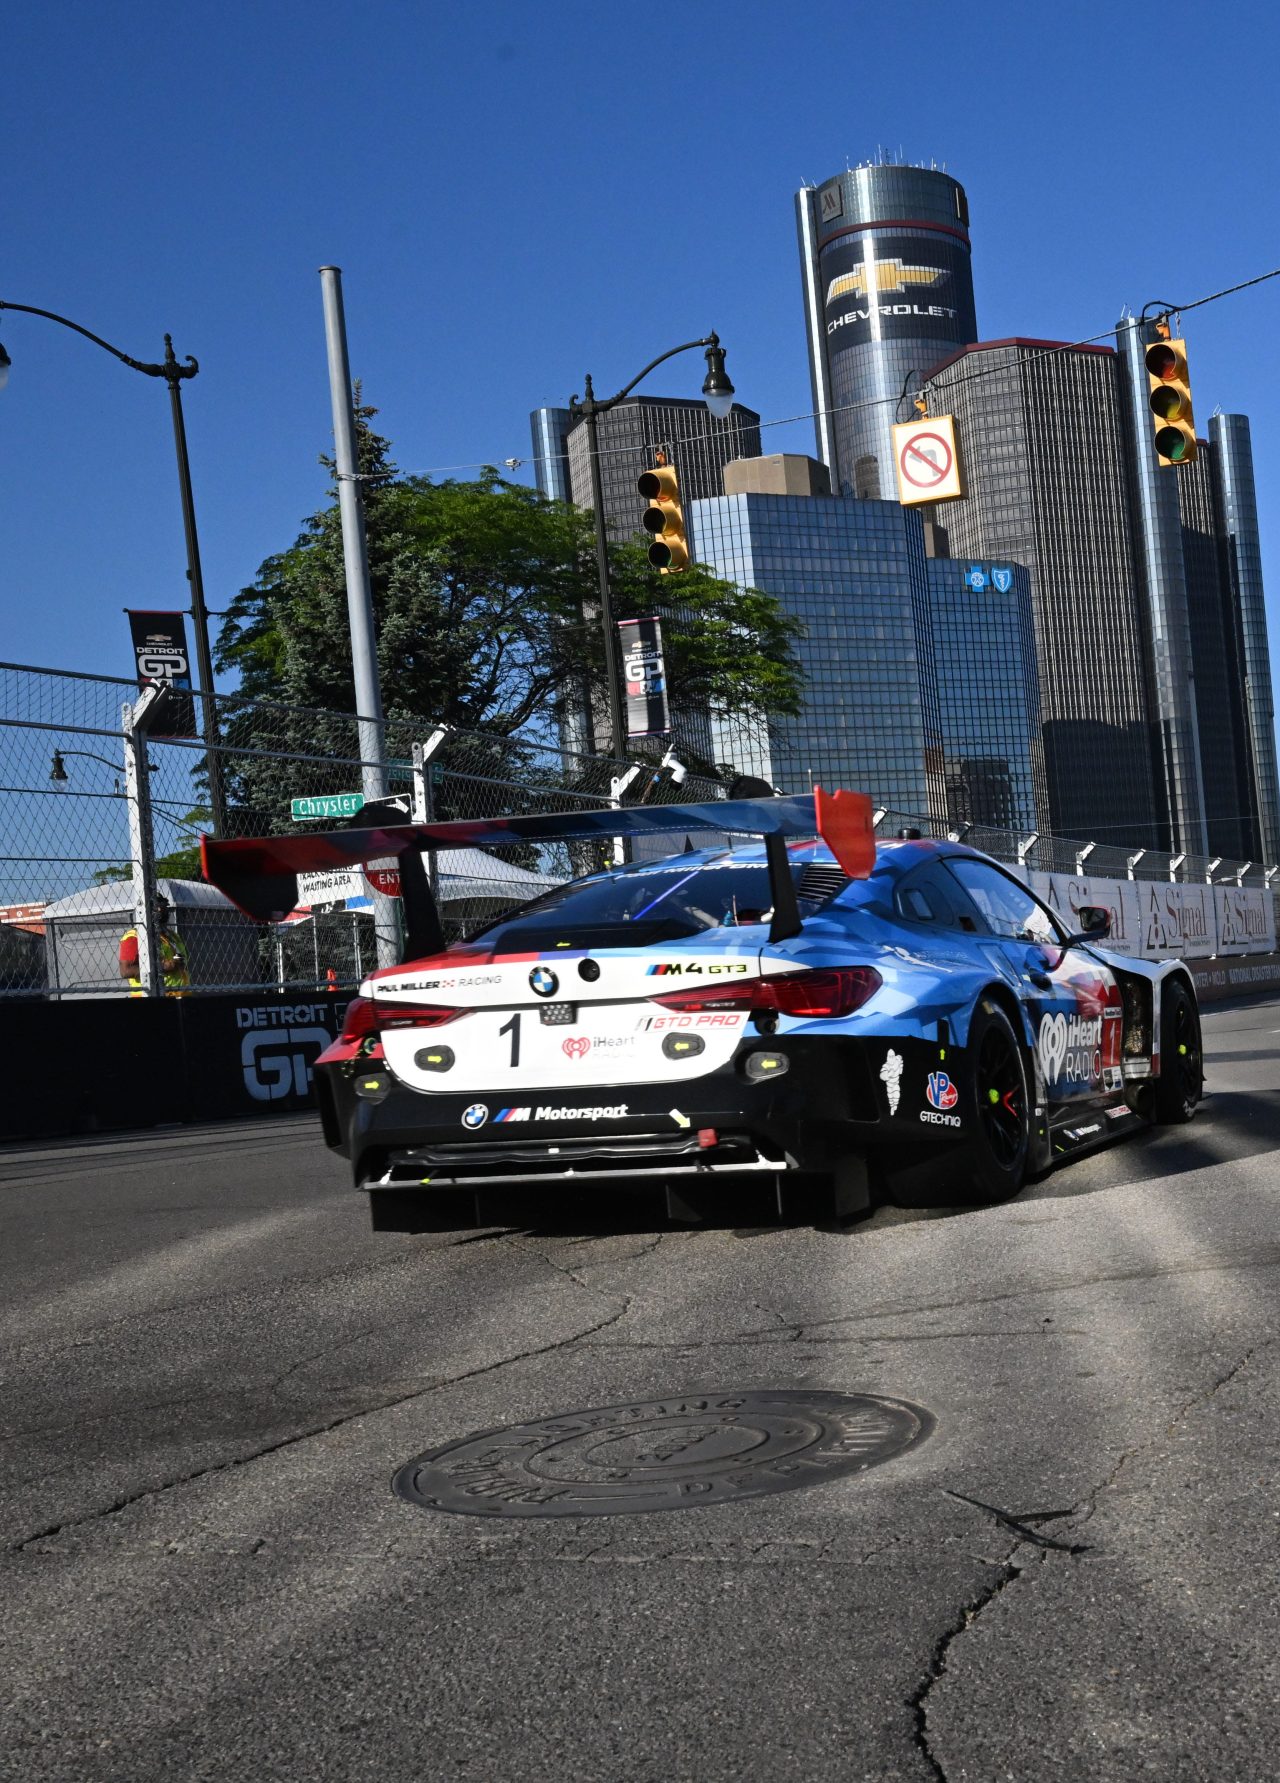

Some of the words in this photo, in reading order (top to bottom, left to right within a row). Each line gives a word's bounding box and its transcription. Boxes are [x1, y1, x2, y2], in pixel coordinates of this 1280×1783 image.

[828, 304, 957, 335] CHEVROLET
[136, 647, 185, 655] DETROIT
[138, 654, 187, 678] GP
[625, 658, 663, 682] GP
[299, 797, 357, 816] Chrysler
[302, 877, 333, 893] WAITING
[334, 874, 352, 887] AREA
[708, 964, 747, 974] GT3
[400, 980, 441, 990] MILLER
[458, 975, 503, 987] RACING
[235, 1003, 328, 1028] DETROIT
[653, 1016, 692, 1029] GTD
[695, 1015, 741, 1027] PRO
[499, 1012, 521, 1068] 1
[1067, 1013, 1103, 1048] iHeart
[593, 1036, 635, 1048] iHeart
[1066, 1049, 1102, 1083] RADIO
[927, 1071, 950, 1107] VP
[534, 1103, 629, 1121] Motorsport
[919, 1110, 962, 1128] GTECHNIQ
